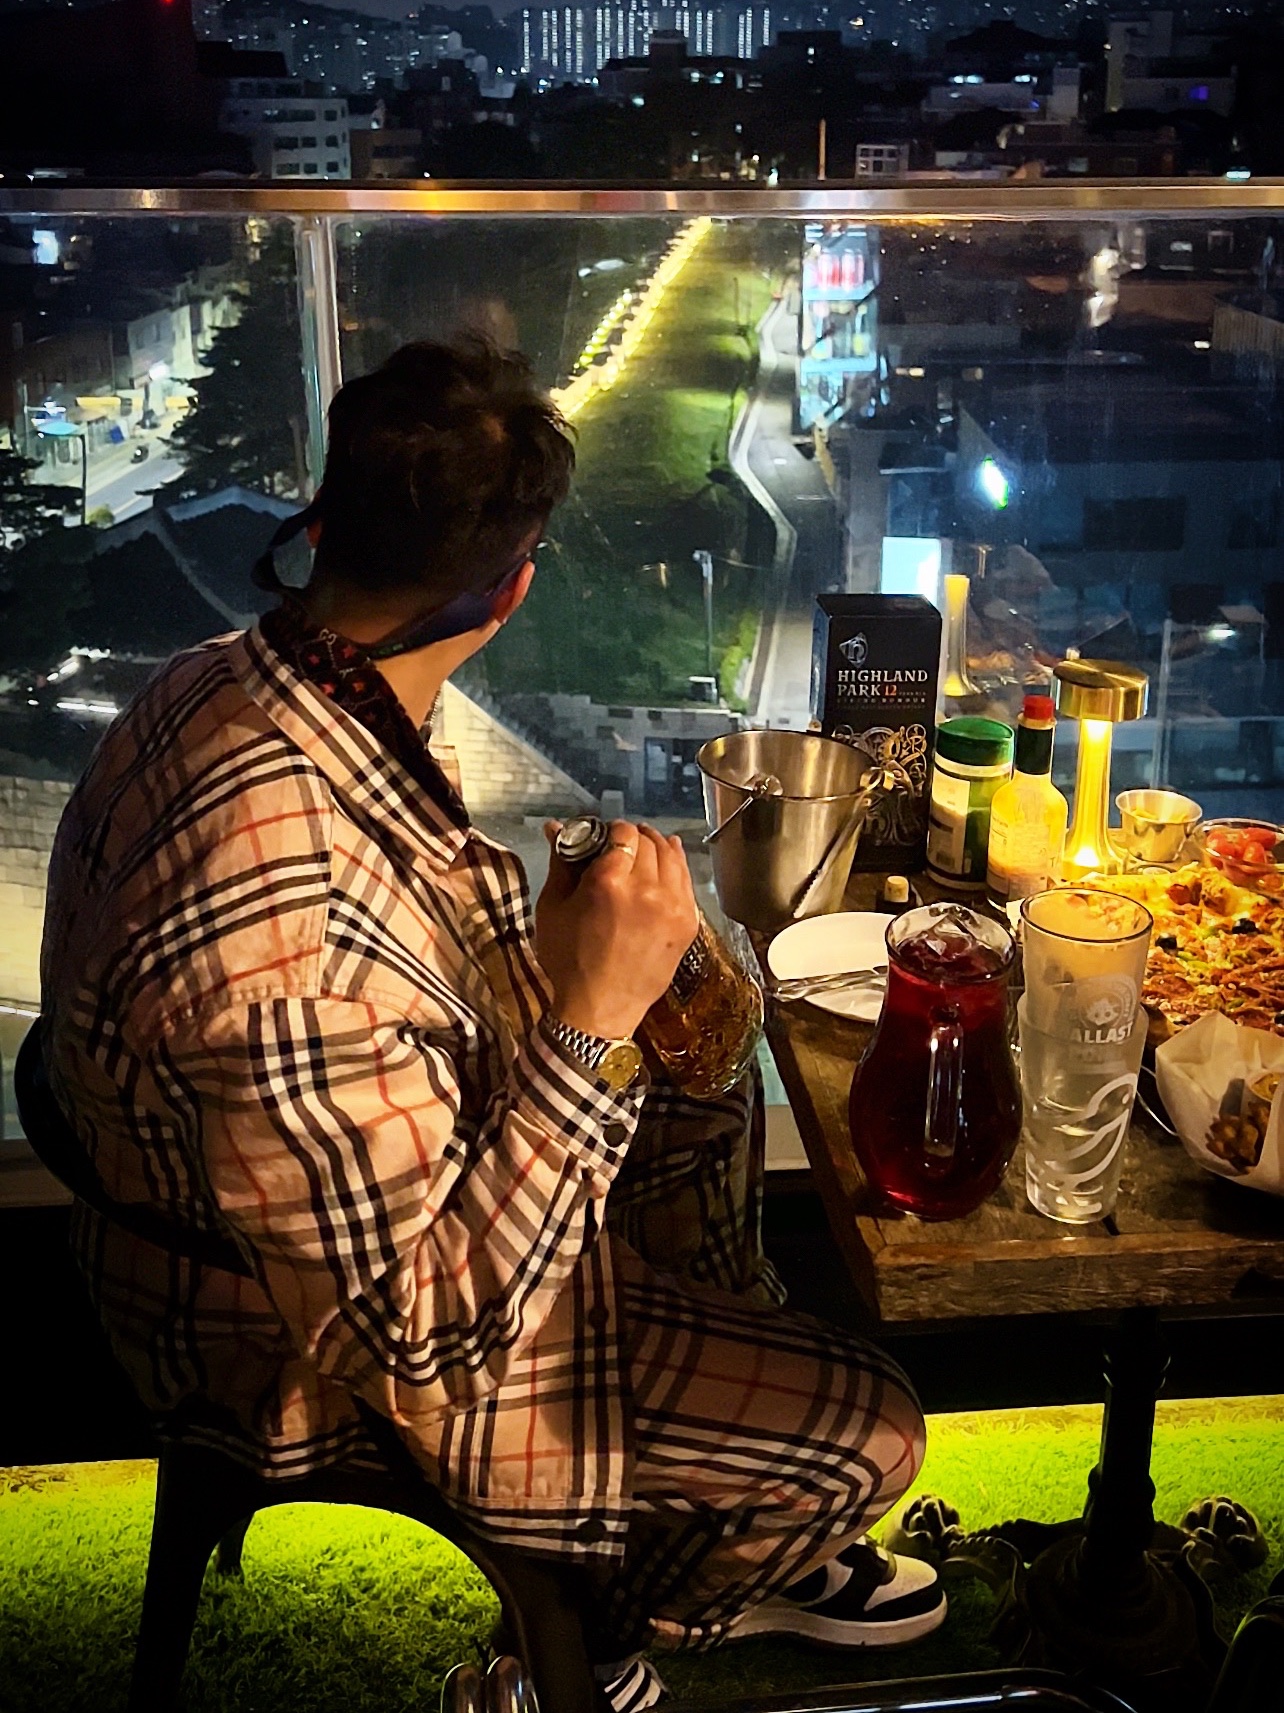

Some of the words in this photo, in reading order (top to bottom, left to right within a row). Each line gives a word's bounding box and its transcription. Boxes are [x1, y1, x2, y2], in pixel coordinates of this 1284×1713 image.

[838, 669, 928, 682] HIGHLAND
[837, 684, 881, 698] PARK
[884, 684, 897, 696] 12
[1069, 1021, 1134, 1043] ALLAST
